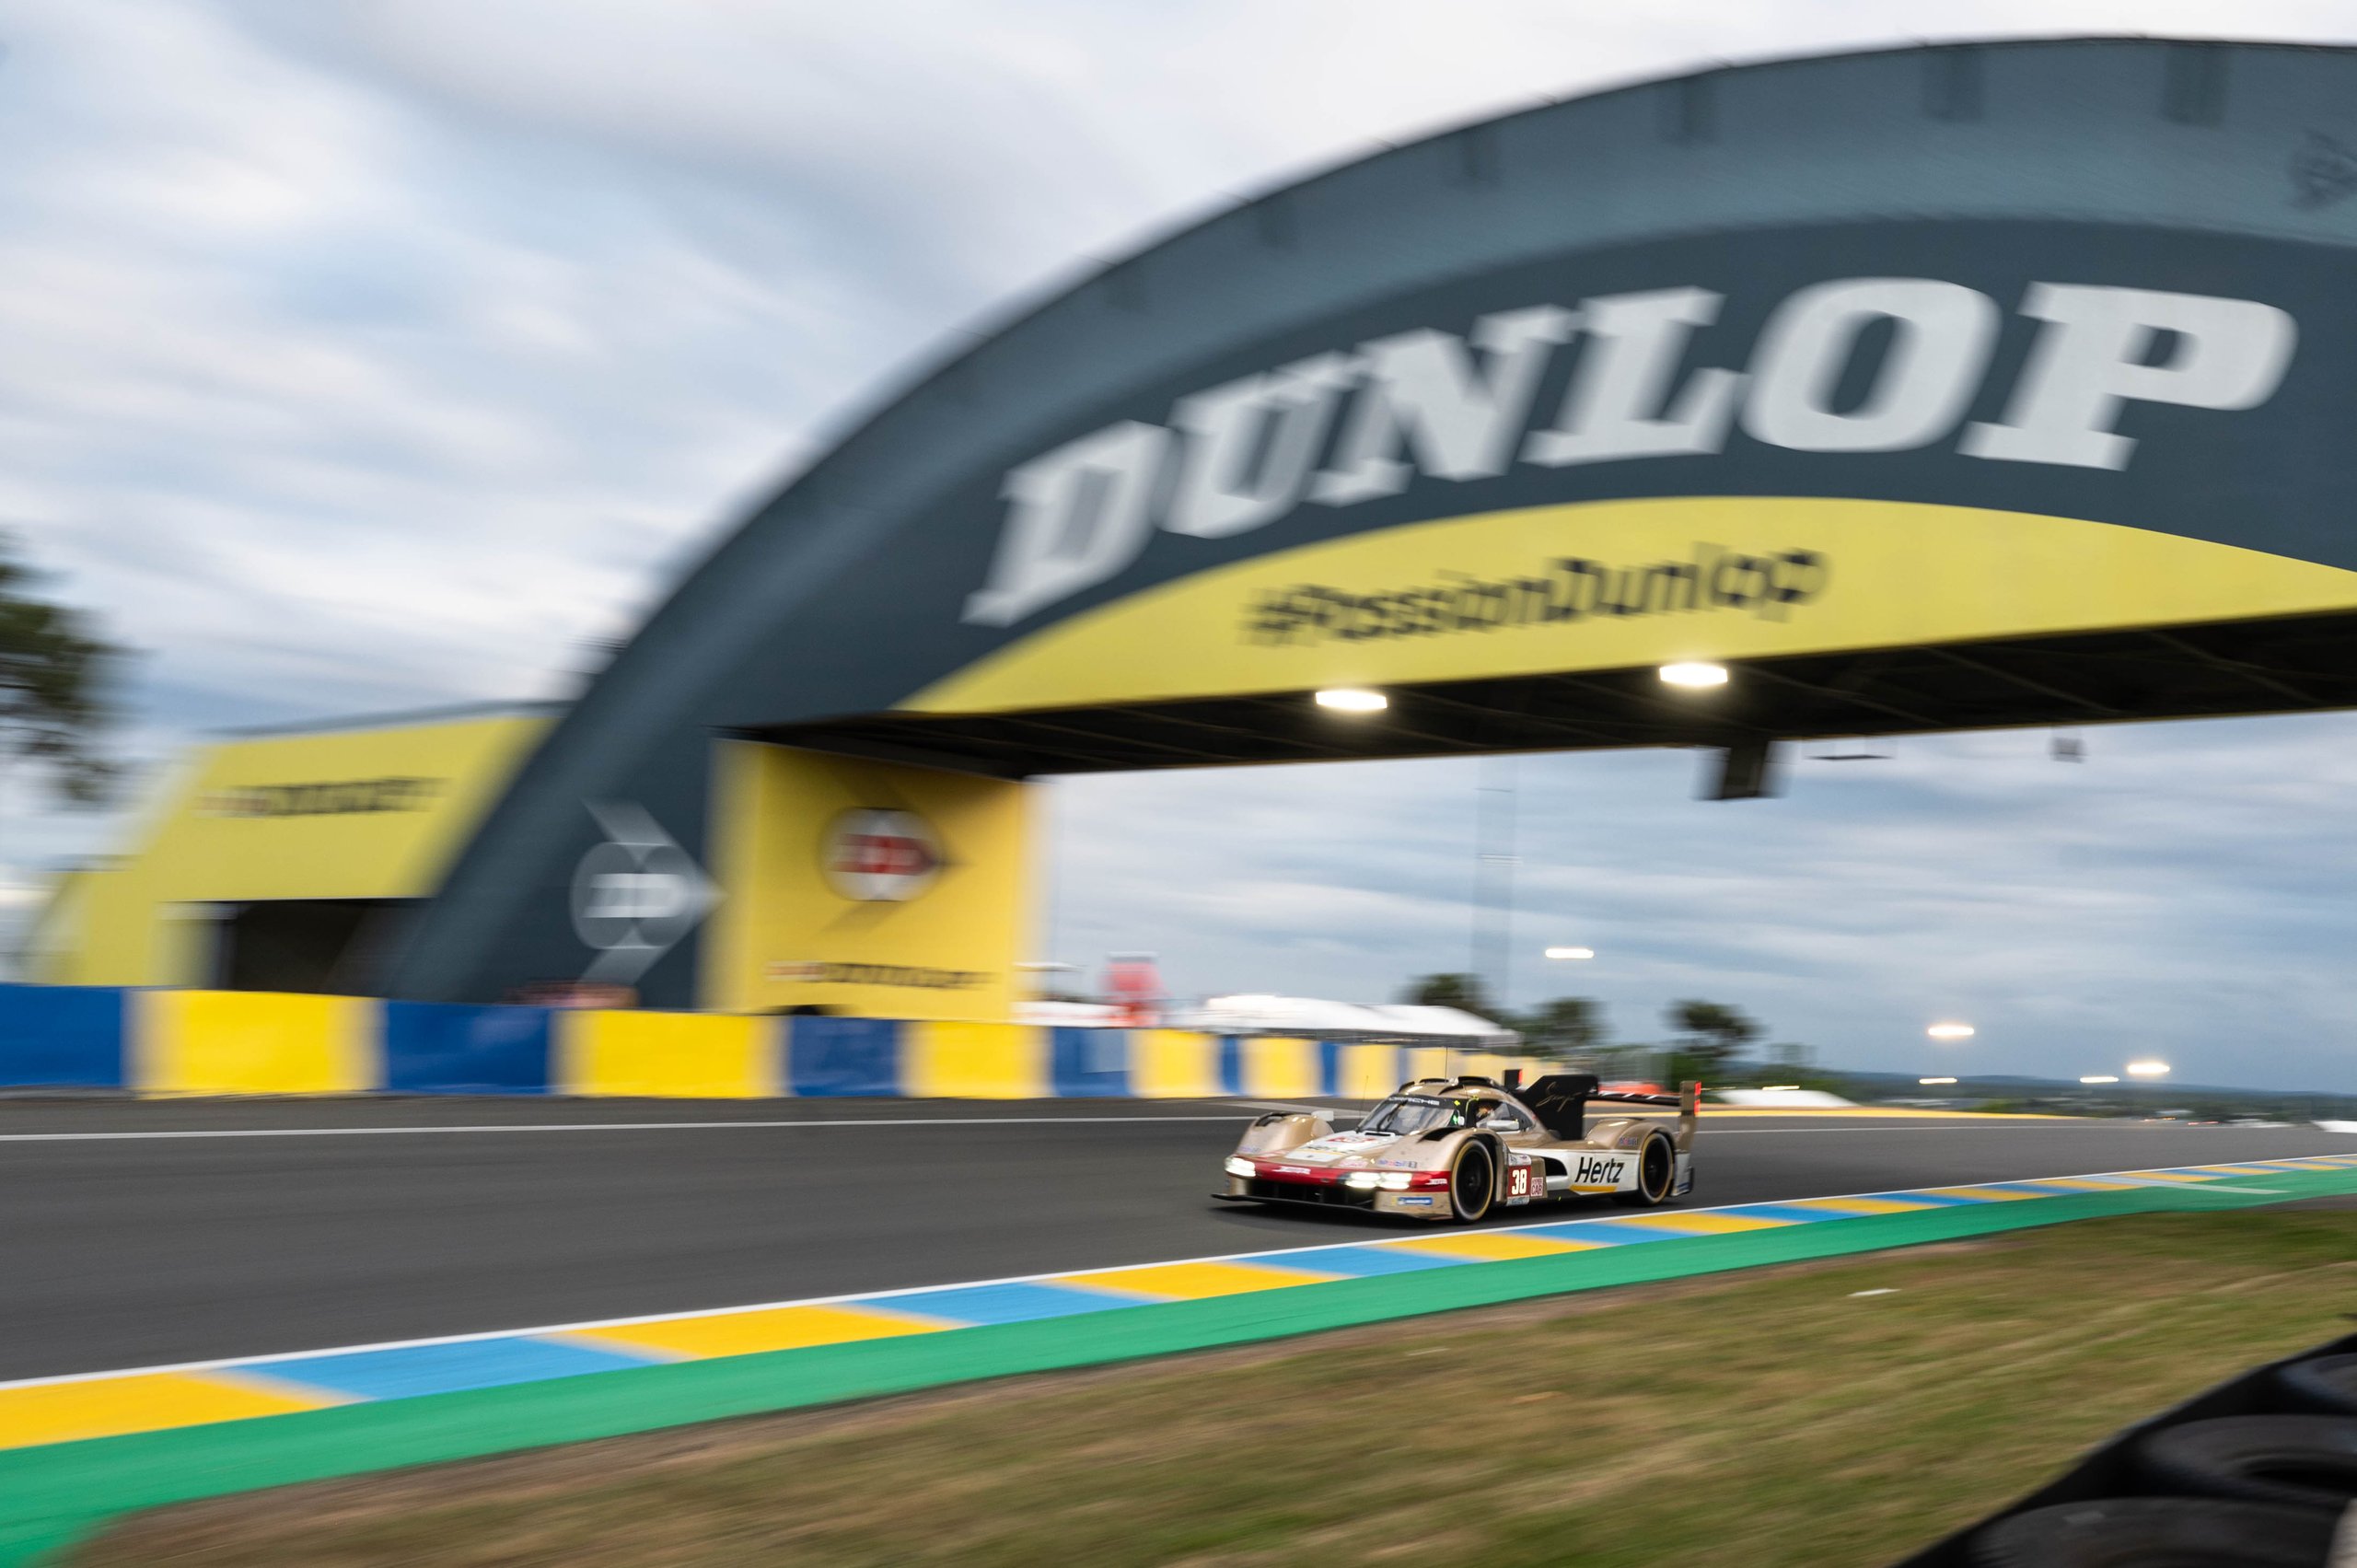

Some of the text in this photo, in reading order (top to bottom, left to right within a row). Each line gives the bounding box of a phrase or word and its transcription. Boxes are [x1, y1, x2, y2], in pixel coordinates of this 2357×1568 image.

[961, 277, 2298, 627] DUNLOP
[1511, 1168, 1527, 1195] 38
[1574, 1156, 1625, 1184] Hertz
